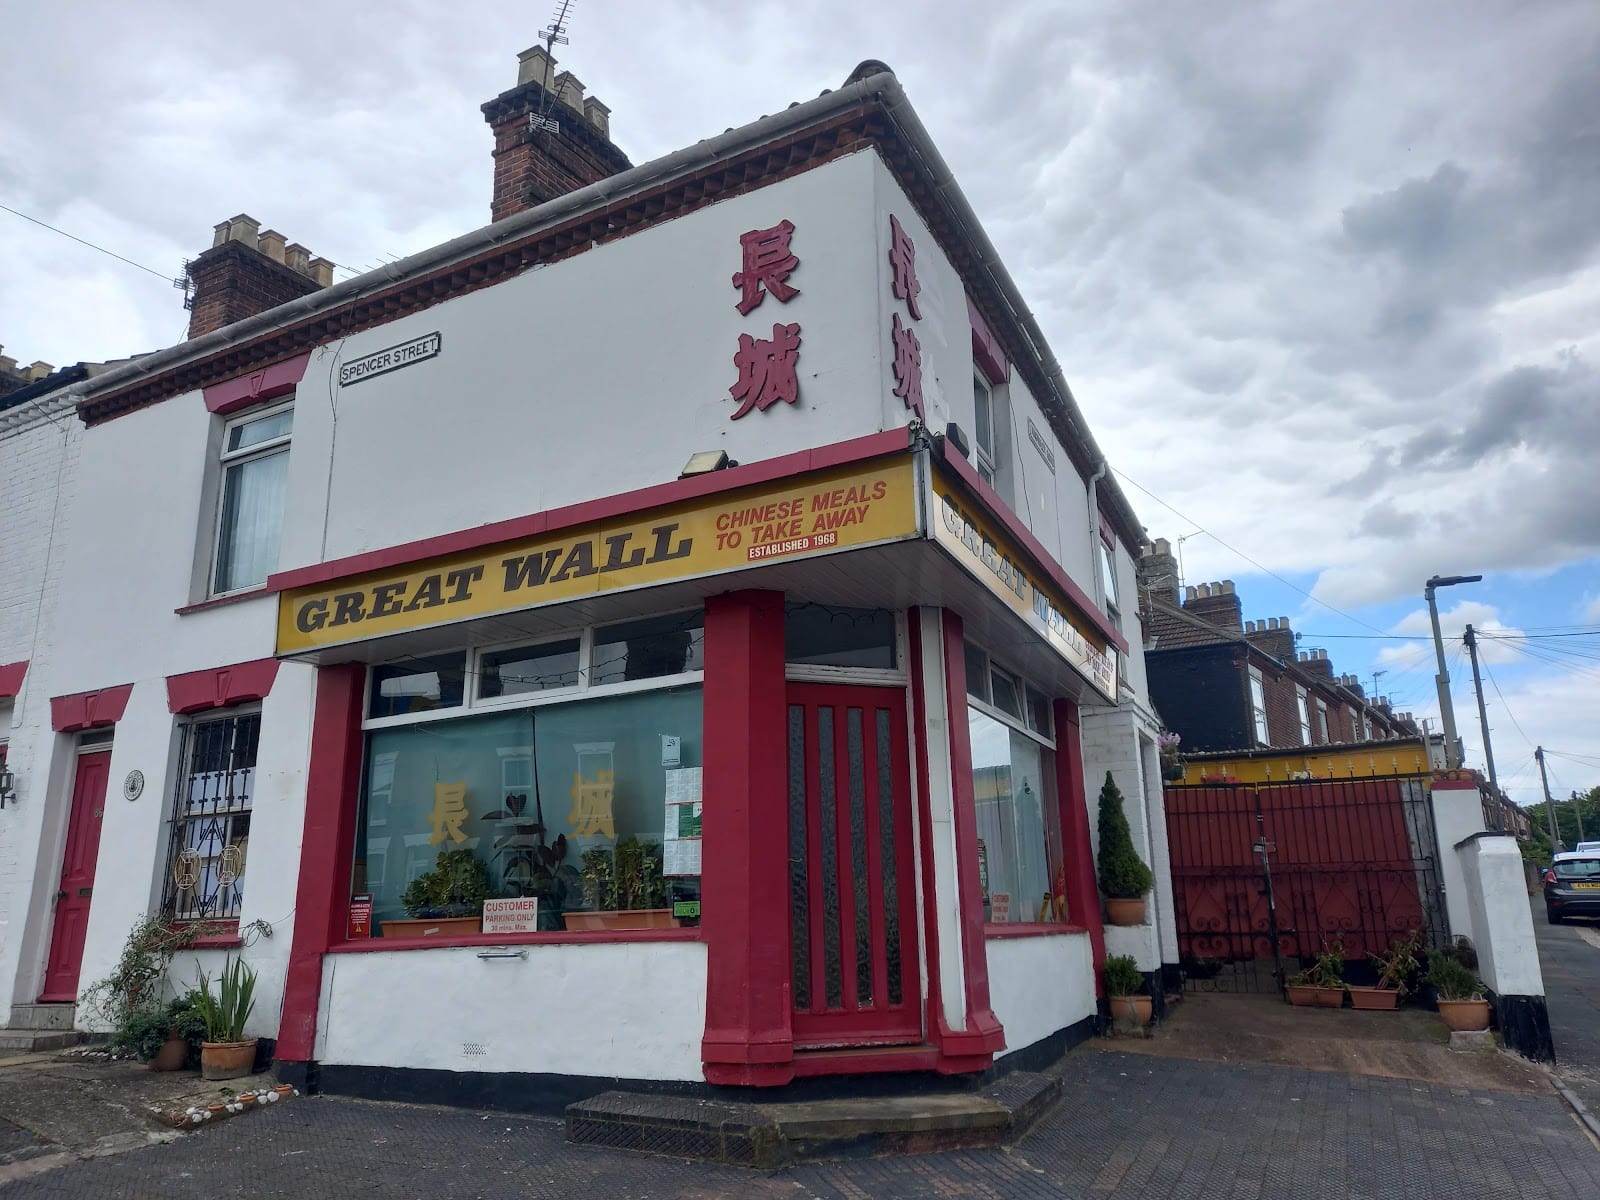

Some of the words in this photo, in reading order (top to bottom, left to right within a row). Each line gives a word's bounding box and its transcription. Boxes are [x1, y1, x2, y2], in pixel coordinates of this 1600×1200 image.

[728, 218, 802, 421] 長城
[341, 353, 391, 381] SPENCER
[392, 338, 437, 363] STREET
[715, 497, 805, 532] CHINESE
[810, 480, 888, 513] MEALS
[715, 530, 742, 551] TO
[750, 517, 804, 545] TAKE
[811, 504, 870, 533] AWAY
[749, 538, 809, 559] ESTABLISHED
[813, 532, 836, 547] 1968
[296, 564, 485, 634] GREAT
[501, 522, 693, 593] WALL
[941, 494, 1028, 602] GREAT
[1032, 581, 1082, 657] WALL
[485, 914, 515, 923] PARKING
[516, 913, 535, 921] ONLY
[486, 901, 534, 912] CUSTOMER
